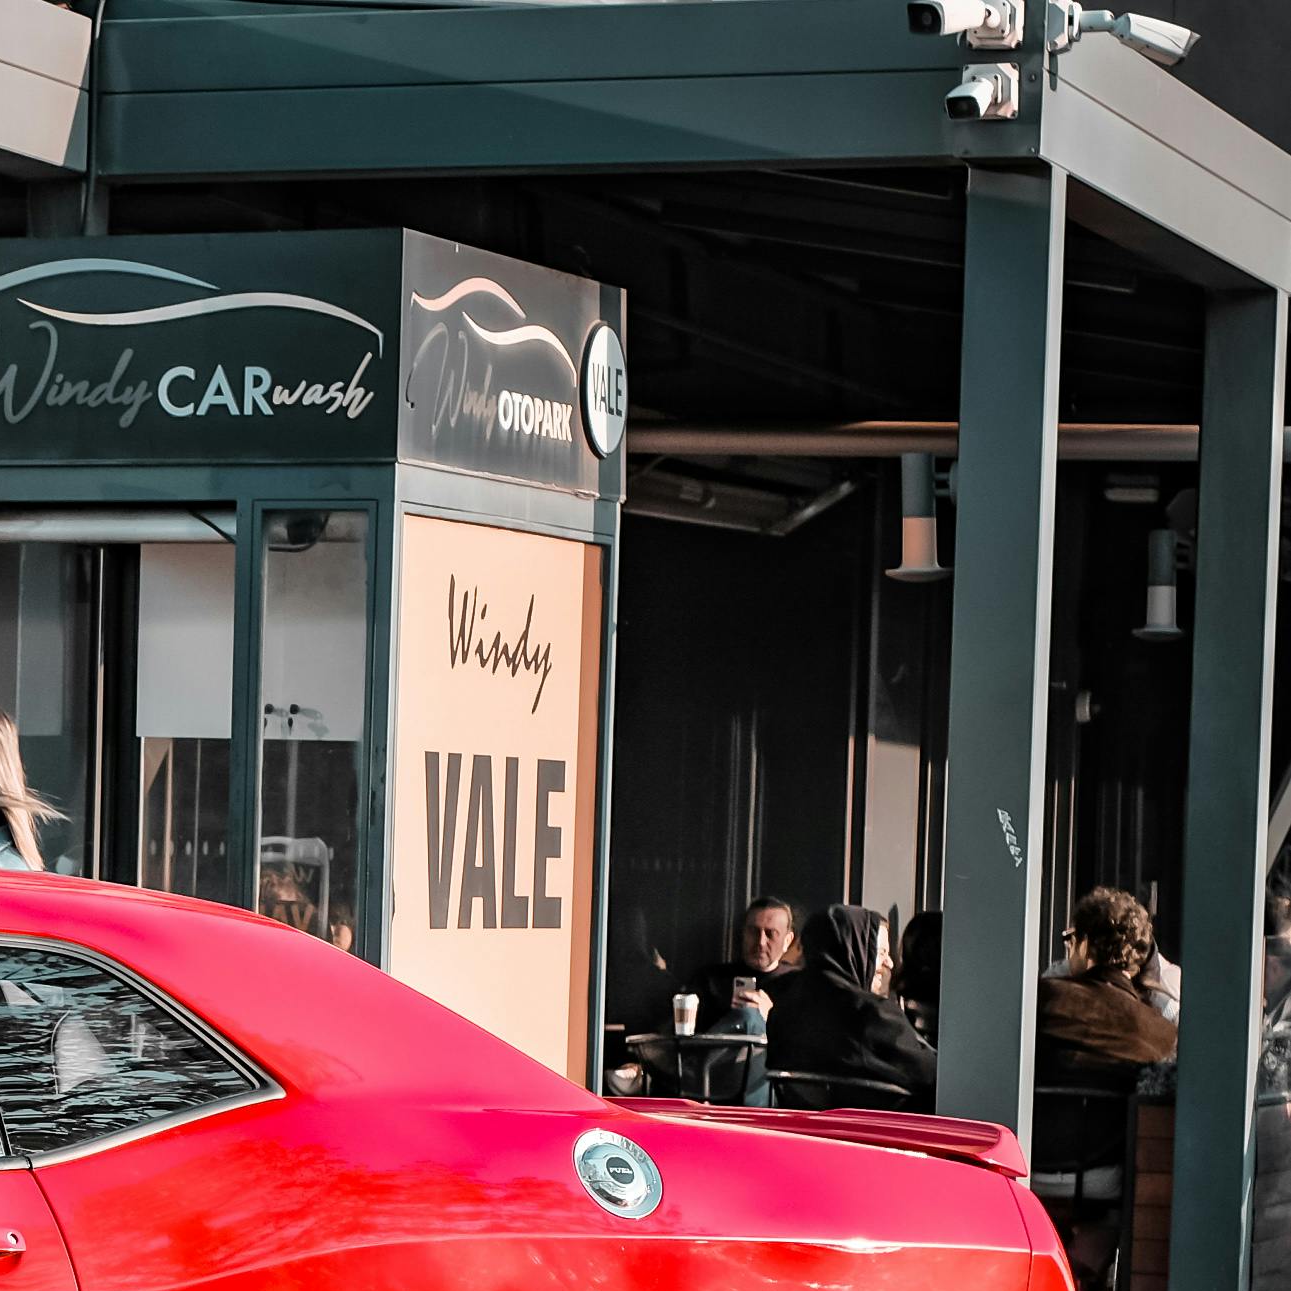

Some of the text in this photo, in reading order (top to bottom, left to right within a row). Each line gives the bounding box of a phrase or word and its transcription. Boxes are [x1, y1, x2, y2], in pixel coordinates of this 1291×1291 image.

[497, 389, 574, 443] OTOPARK
[592, 362, 624, 418] VALE
[448, 573, 553, 714] Windy
[424, 750, 567, 930] VALE
